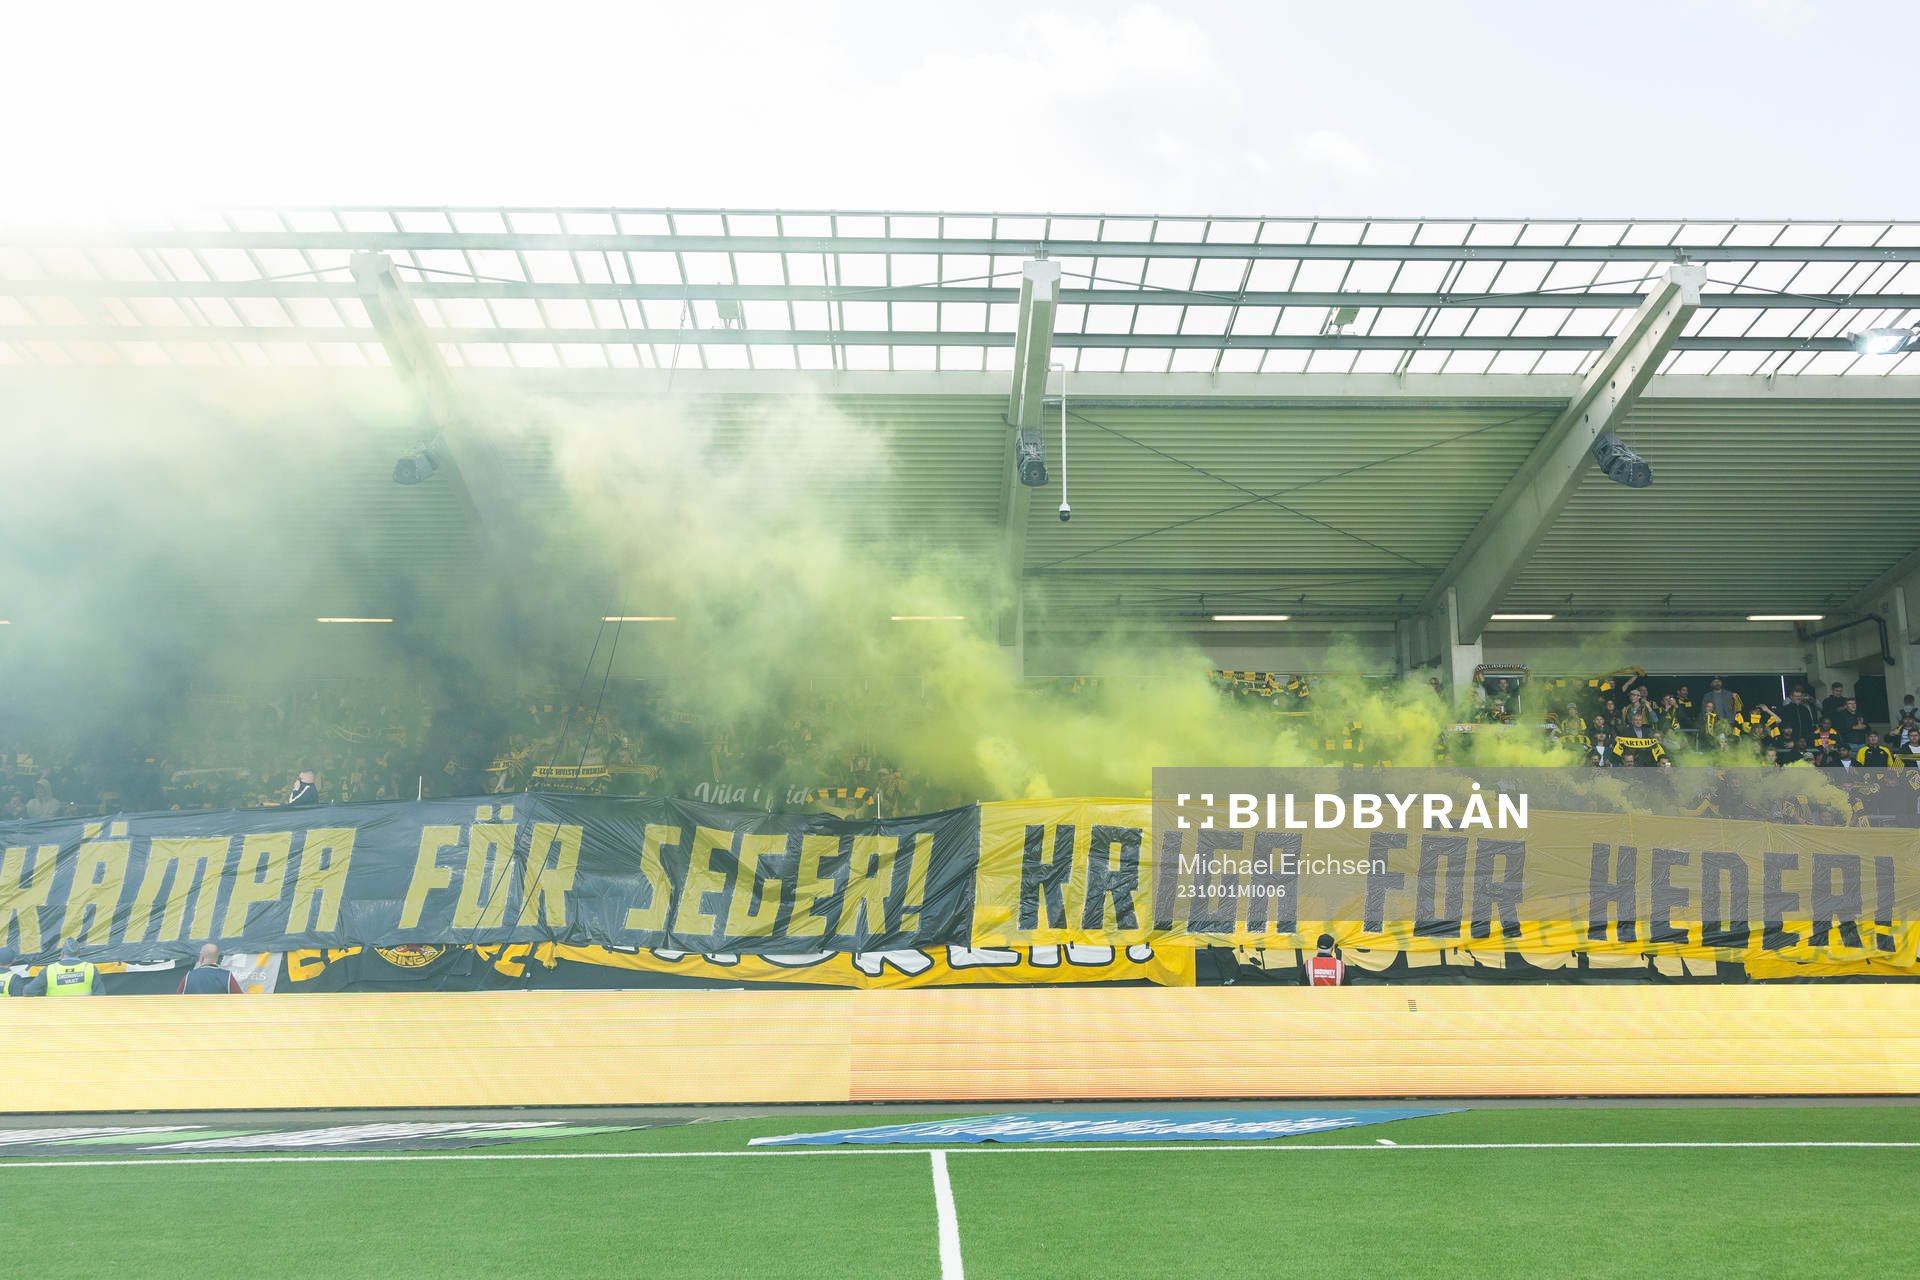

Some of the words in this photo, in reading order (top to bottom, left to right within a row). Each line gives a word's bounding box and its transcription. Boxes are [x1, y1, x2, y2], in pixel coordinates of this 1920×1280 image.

[694, 782, 747, 805] Vila
[0, 821, 357, 954] KÄMPA
[399, 805, 584, 930] FÖR
[625, 824, 936, 937] SEGER!
[1017, 824, 1303, 936] KRIGA
[1363, 818, 1526, 938] FÖR
[1587, 842, 1897, 953] HEDER!
